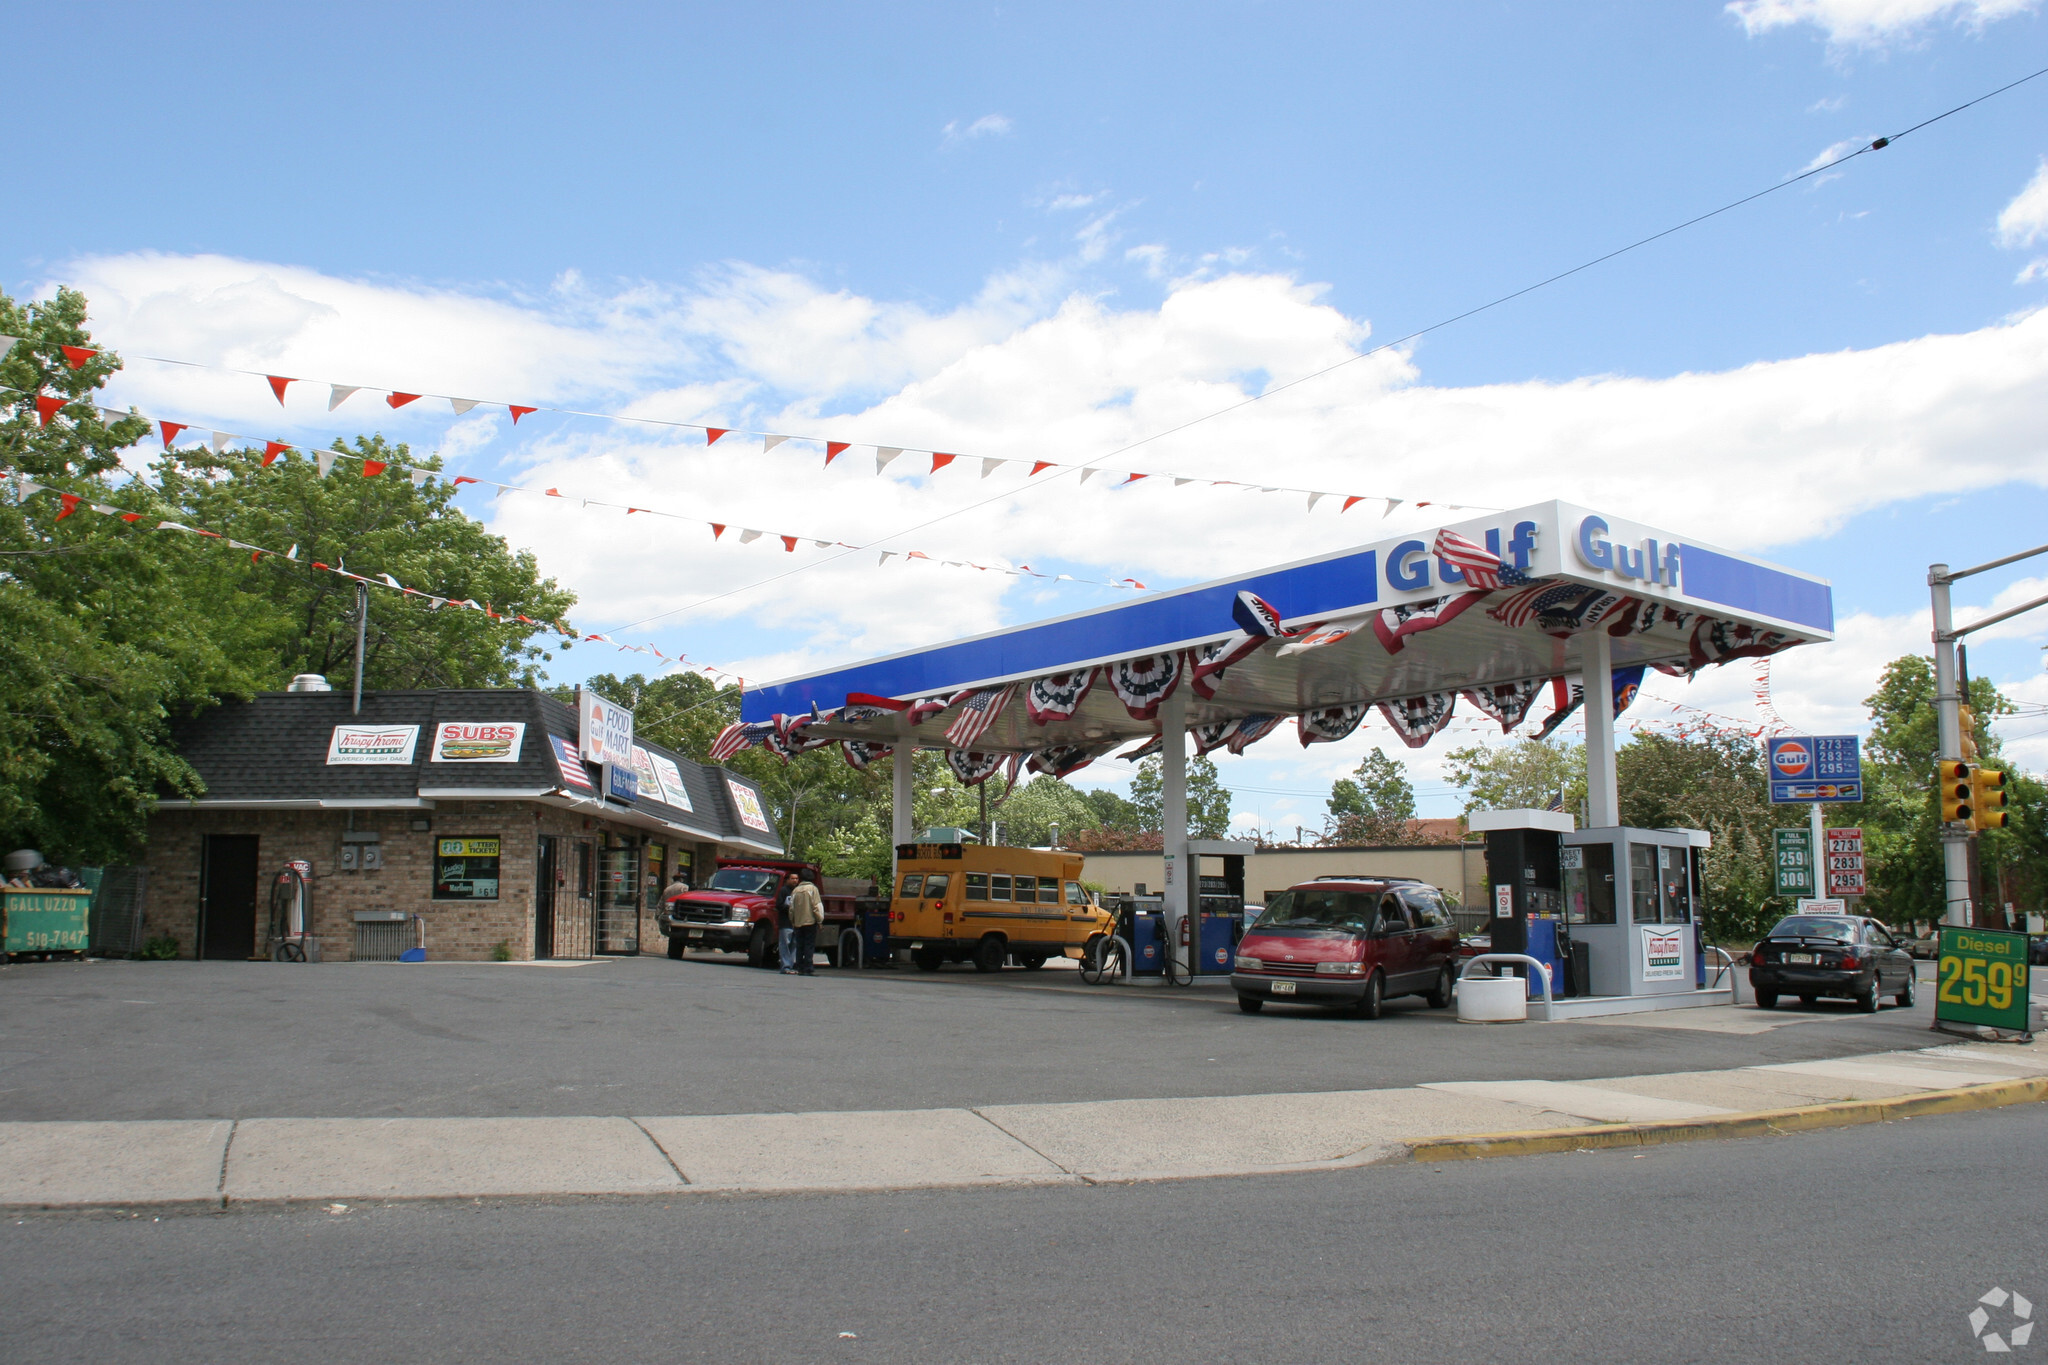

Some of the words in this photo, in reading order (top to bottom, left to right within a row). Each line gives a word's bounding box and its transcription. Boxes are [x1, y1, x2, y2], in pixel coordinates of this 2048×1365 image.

[1385, 520, 1538, 592] Gulf
[1575, 515, 1680, 588] Gulf
[606, 708, 630, 733] FOOD
[442, 724, 517, 740] SUBS
[591, 720, 604, 739] Gulf
[340, 734, 375, 748] Krispy
[373, 734, 406, 747] Kreme
[604, 729, 630, 755] MART
[1818, 739, 1842, 750] 273
[1775, 754, 1808, 764] Gulf
[1820, 751, 1842, 762] 283
[1820, 763, 1843, 774] 295
[730, 781, 756, 798] OPEN
[739, 794, 759, 818] 24
[742, 814, 768, 830] HOURS
[1833, 840, 1854, 852] 273
[1780, 851, 1803, 866] 259
[1834, 857, 1855, 869] 283
[1780, 872, 1804, 887] 309
[1835, 874, 1856, 887] 295
[26, 930, 85, 947] 518-7847
[1957, 936, 2011, 954] Diesel
[1649, 938, 1664, 957] Krispy
[1663, 938, 1679, 954] Kreme
